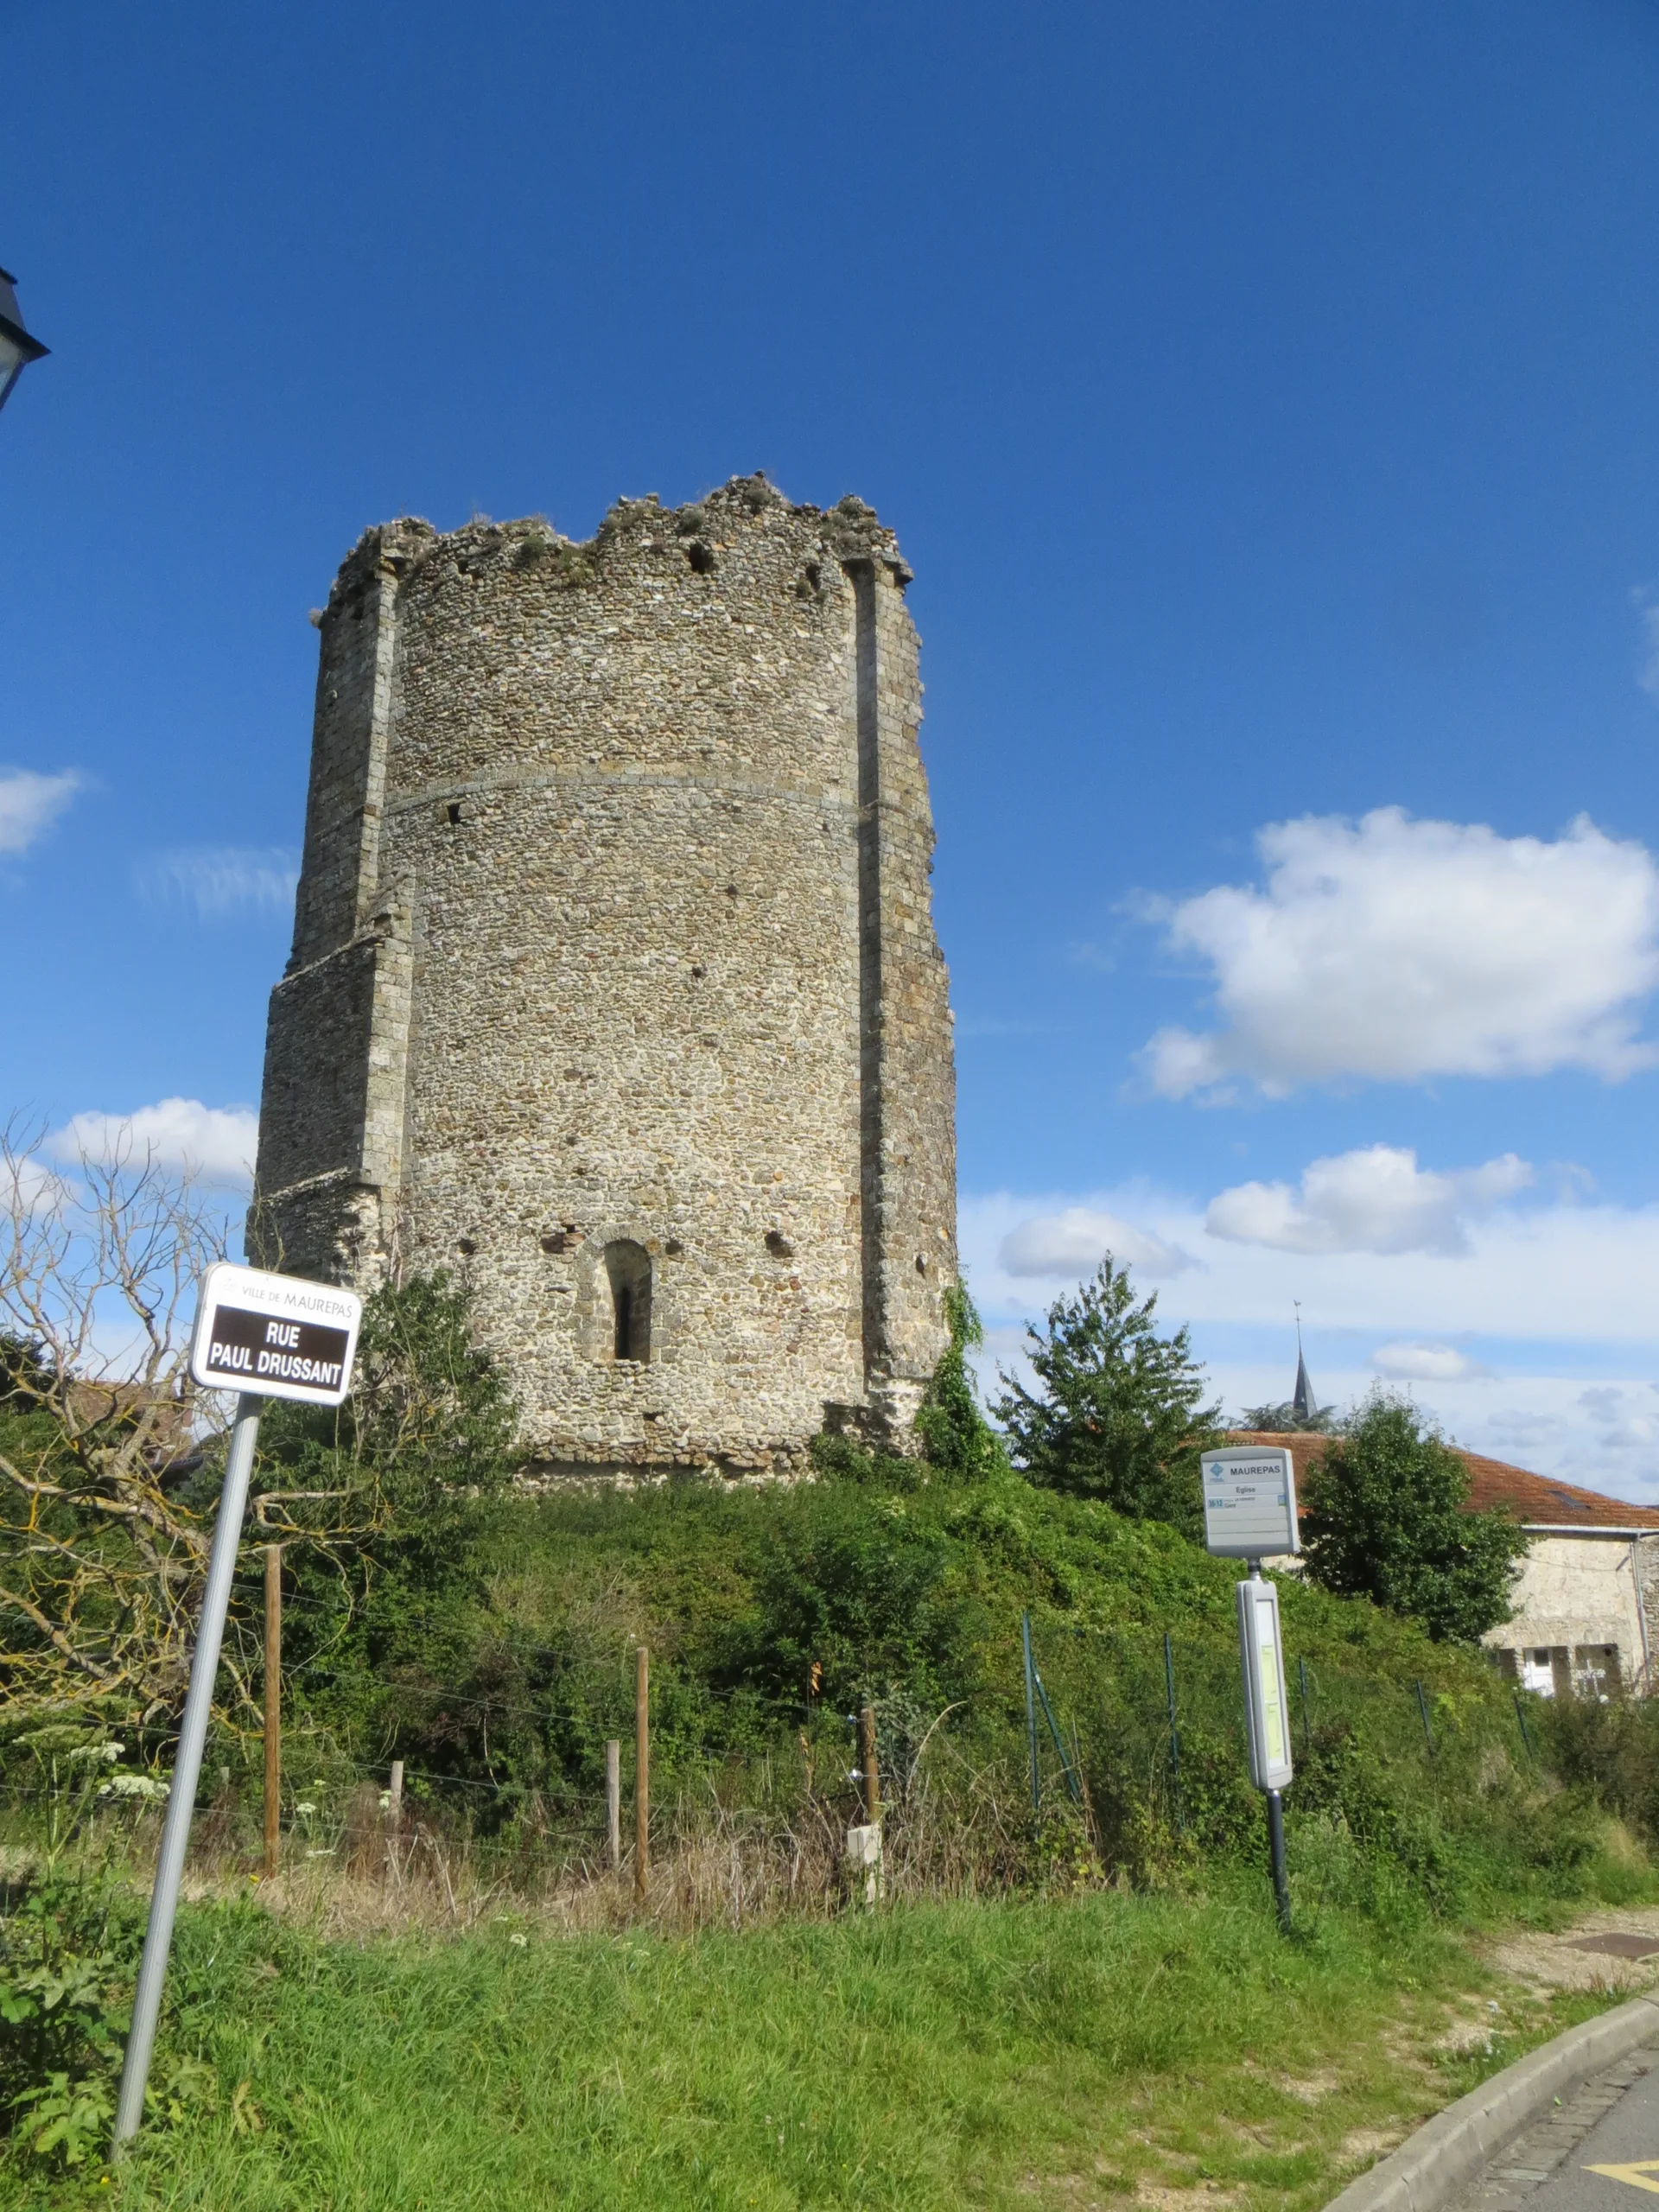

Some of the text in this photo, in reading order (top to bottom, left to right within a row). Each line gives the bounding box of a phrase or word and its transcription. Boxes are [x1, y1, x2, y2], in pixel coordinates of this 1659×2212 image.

[243, 1286, 353, 1318] VILLE DE MAUREPAS
[266, 1321, 301, 1348] RUE
[210, 1342, 342, 1385] PAUL DRUSSANT
[1230, 1465, 1281, 1476] MAUREPAS
